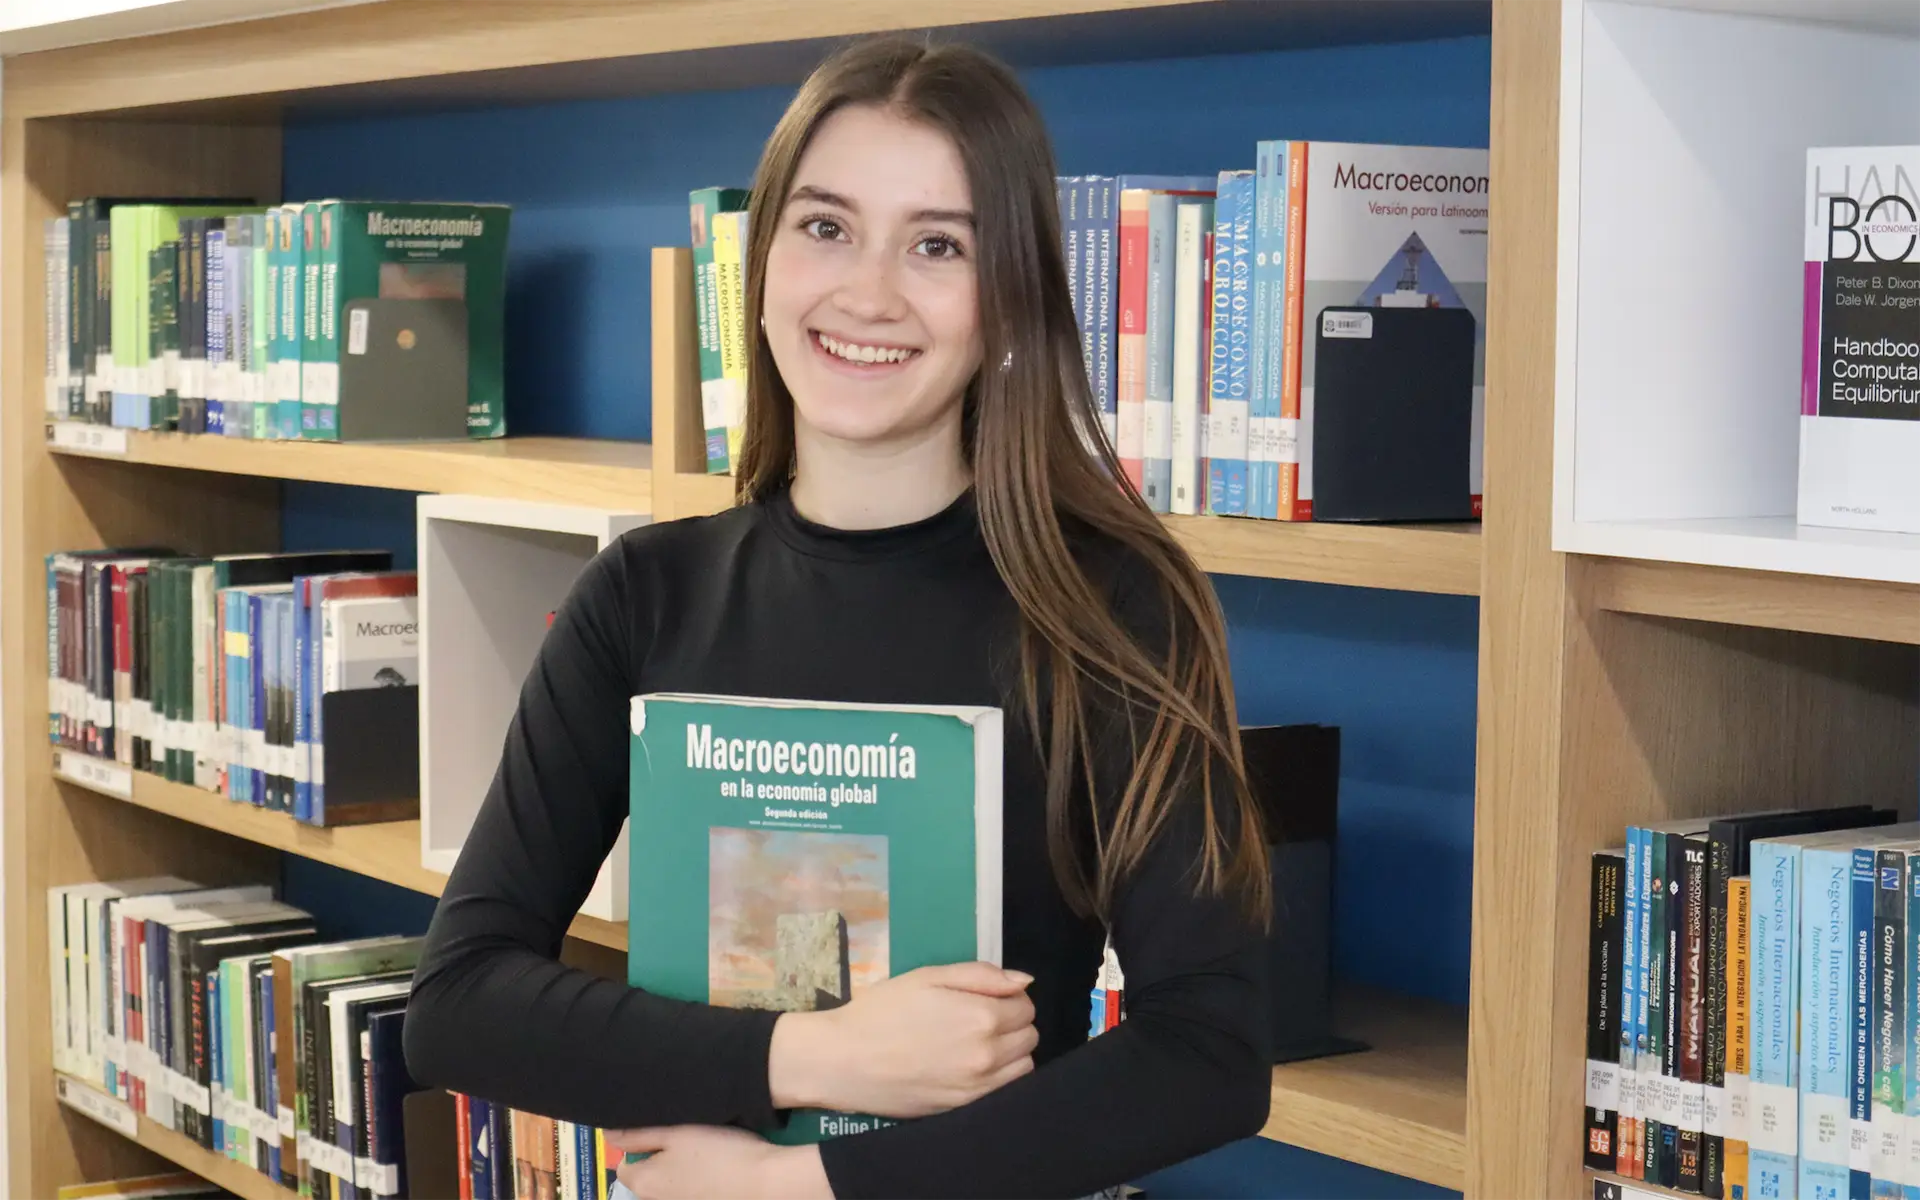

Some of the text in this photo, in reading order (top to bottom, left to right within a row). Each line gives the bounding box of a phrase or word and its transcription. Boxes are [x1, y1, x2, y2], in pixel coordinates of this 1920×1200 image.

[367, 211, 483, 237] Macroeconomía
[1368, 201, 1407, 216] Versión
[1412, 204, 1437, 219] para
[1872, 224, 1918, 233] ECONOMICS
[1084, 229, 1095, 329] INTERNATIONAL
[1099, 229, 1110, 329] INTERNATIONAL
[1836, 277, 1920, 289] Peter B. Dixon
[707, 263, 719, 352] Macroeconomía
[1836, 294, 1920, 309] Dale W. Jorgen
[687, 723, 916, 779] Macroeconomía
[720, 779, 877, 807] en la economía global
[765, 806, 828, 820] Segunda edición
[1626, 843, 1636, 899] Exportadores
[1641, 845, 1652, 900] Exportadores
[1685, 849, 1705, 863] TLC
[1694, 865, 1702, 936] EXPORTADORES
[1738, 885, 1747, 954] LATINOAMERICANA
[1624, 909, 1635, 966] Importadores
[1641, 912, 1651, 969] Importadores
[1708, 907, 1718, 983] ECONOMIC
[1757, 914, 1768, 987] Introducción
[1884, 925, 1895, 965] Cómo
[1601, 973, 1607, 981] la
[1717, 908, 1728, 1019] INTERNATIONAL
[1772, 856, 1787, 1060] Negocios Internacionales
[1812, 926, 1823, 999] Introducción
[1828, 866, 1844, 1074] Negocios Internacionales
[1858, 930, 1867, 1004] MERCADERÍAS
[1600, 988, 1608, 1009] plata
[1624, 969, 1633, 990] para
[1640, 972, 1648, 992] para
[1687, 937, 1701, 1060] MANUAL
[1884, 969, 1894, 1008] Hacer
[1599, 1018, 1606, 1031] De
[1600, 1010, 1607, 1018] la
[1622, 992, 1632, 1022] Manual
[1638, 995, 1648, 1025] Manual
[1737, 1011, 1744, 1021] LA
[1756, 999, 1766, 1047] aspectos
[1715, 1023, 1724, 1071] TRADE
[1810, 1013, 1821, 1061] aspectos
[1858, 1030, 1866, 1043] DE
[1881, 1011, 1893, 1073] Negocios
[1858, 1088, 1865, 1101] DE
[1646, 1127, 1654, 1168] Rogelio
[1681, 1153, 1697, 1167] 13
[1681, 1166, 1697, 1176] 2012
